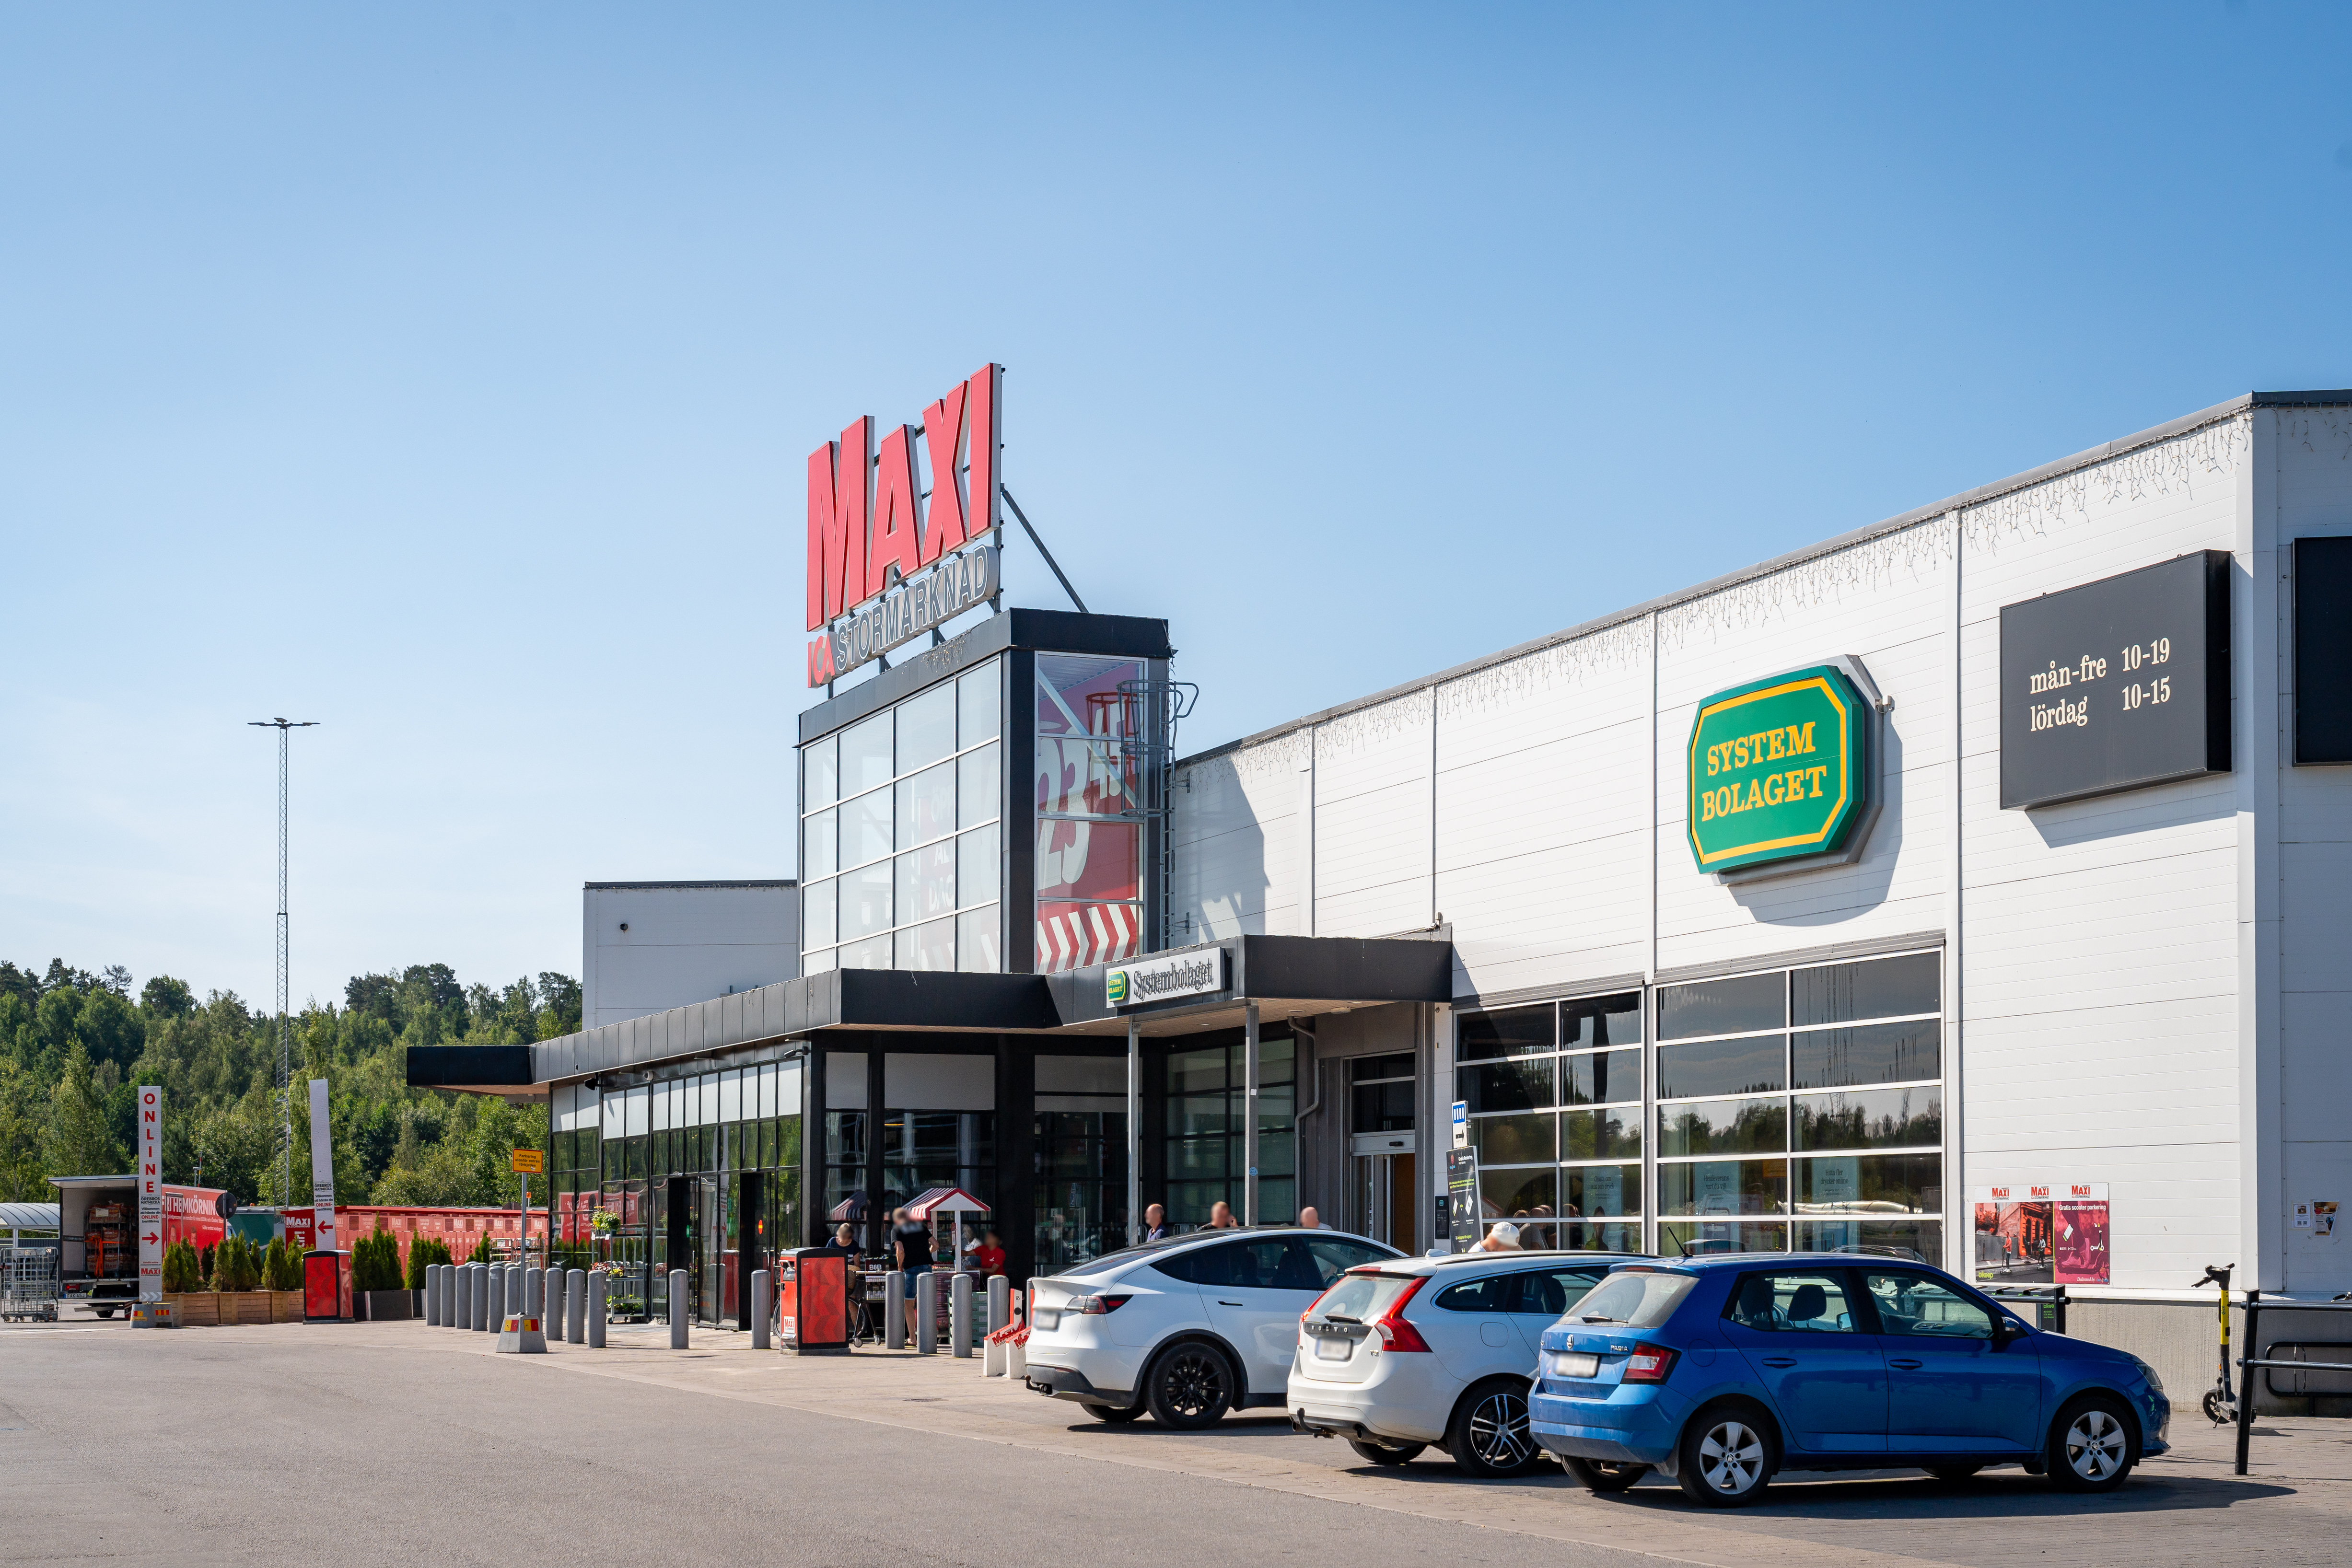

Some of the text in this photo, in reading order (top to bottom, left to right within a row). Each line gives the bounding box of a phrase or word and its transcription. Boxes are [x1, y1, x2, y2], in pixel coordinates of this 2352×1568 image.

[807, 362, 1000, 632] MAXI
[807, 545, 997, 688] ICA STORMARKNAD
[2030, 637, 2170, 694] mån-fre 10-19
[2030, 675, 2171, 732] lördag 10-15
[1707, 721, 1816, 777] SYSTEM
[1701, 765, 1827, 822] BOLAGET
[1133, 958, 1213, 1001] Systembolaget
[144, 1093, 156, 1193] ONLINE
[1820, 1177, 1835, 1185] drycker
[1991, 1187, 2009, 1197] MAXI
[2031, 1186, 2049, 1196] MAXI
[2071, 1185, 2090, 1195] MAXI
[173, 1194, 219, 1217] HEMKÖRNIN
[286, 1217, 311, 1225] MAXI
[1978, 1271, 1993, 1280] bikeep
[784, 1319, 794, 1328] MAXI
[1311, 1324, 1348, 1333] VOLVO
